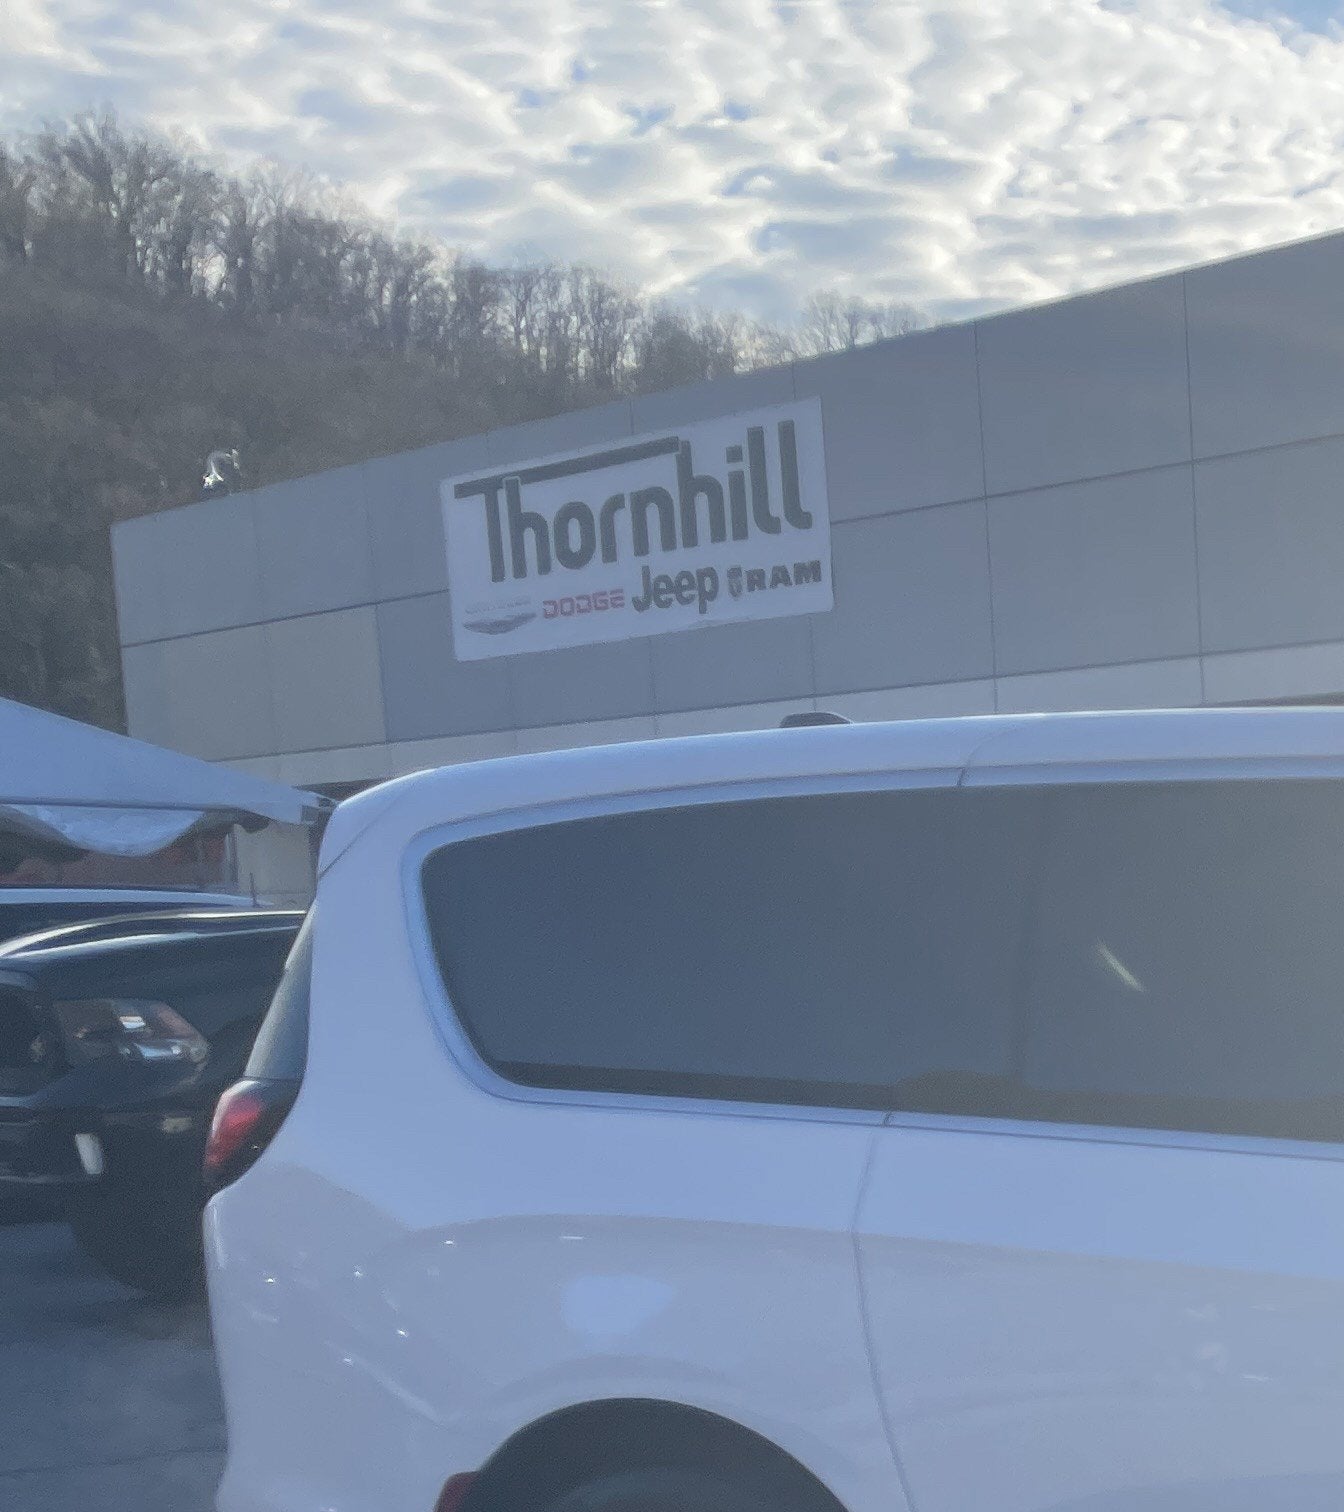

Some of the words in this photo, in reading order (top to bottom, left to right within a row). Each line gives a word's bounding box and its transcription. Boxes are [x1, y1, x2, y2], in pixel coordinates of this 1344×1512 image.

[454, 420, 813, 582] Thornhill
[543, 589, 625, 618] DODGE
[631, 565, 719, 614] Jeep
[746, 560, 822, 592] RAM
